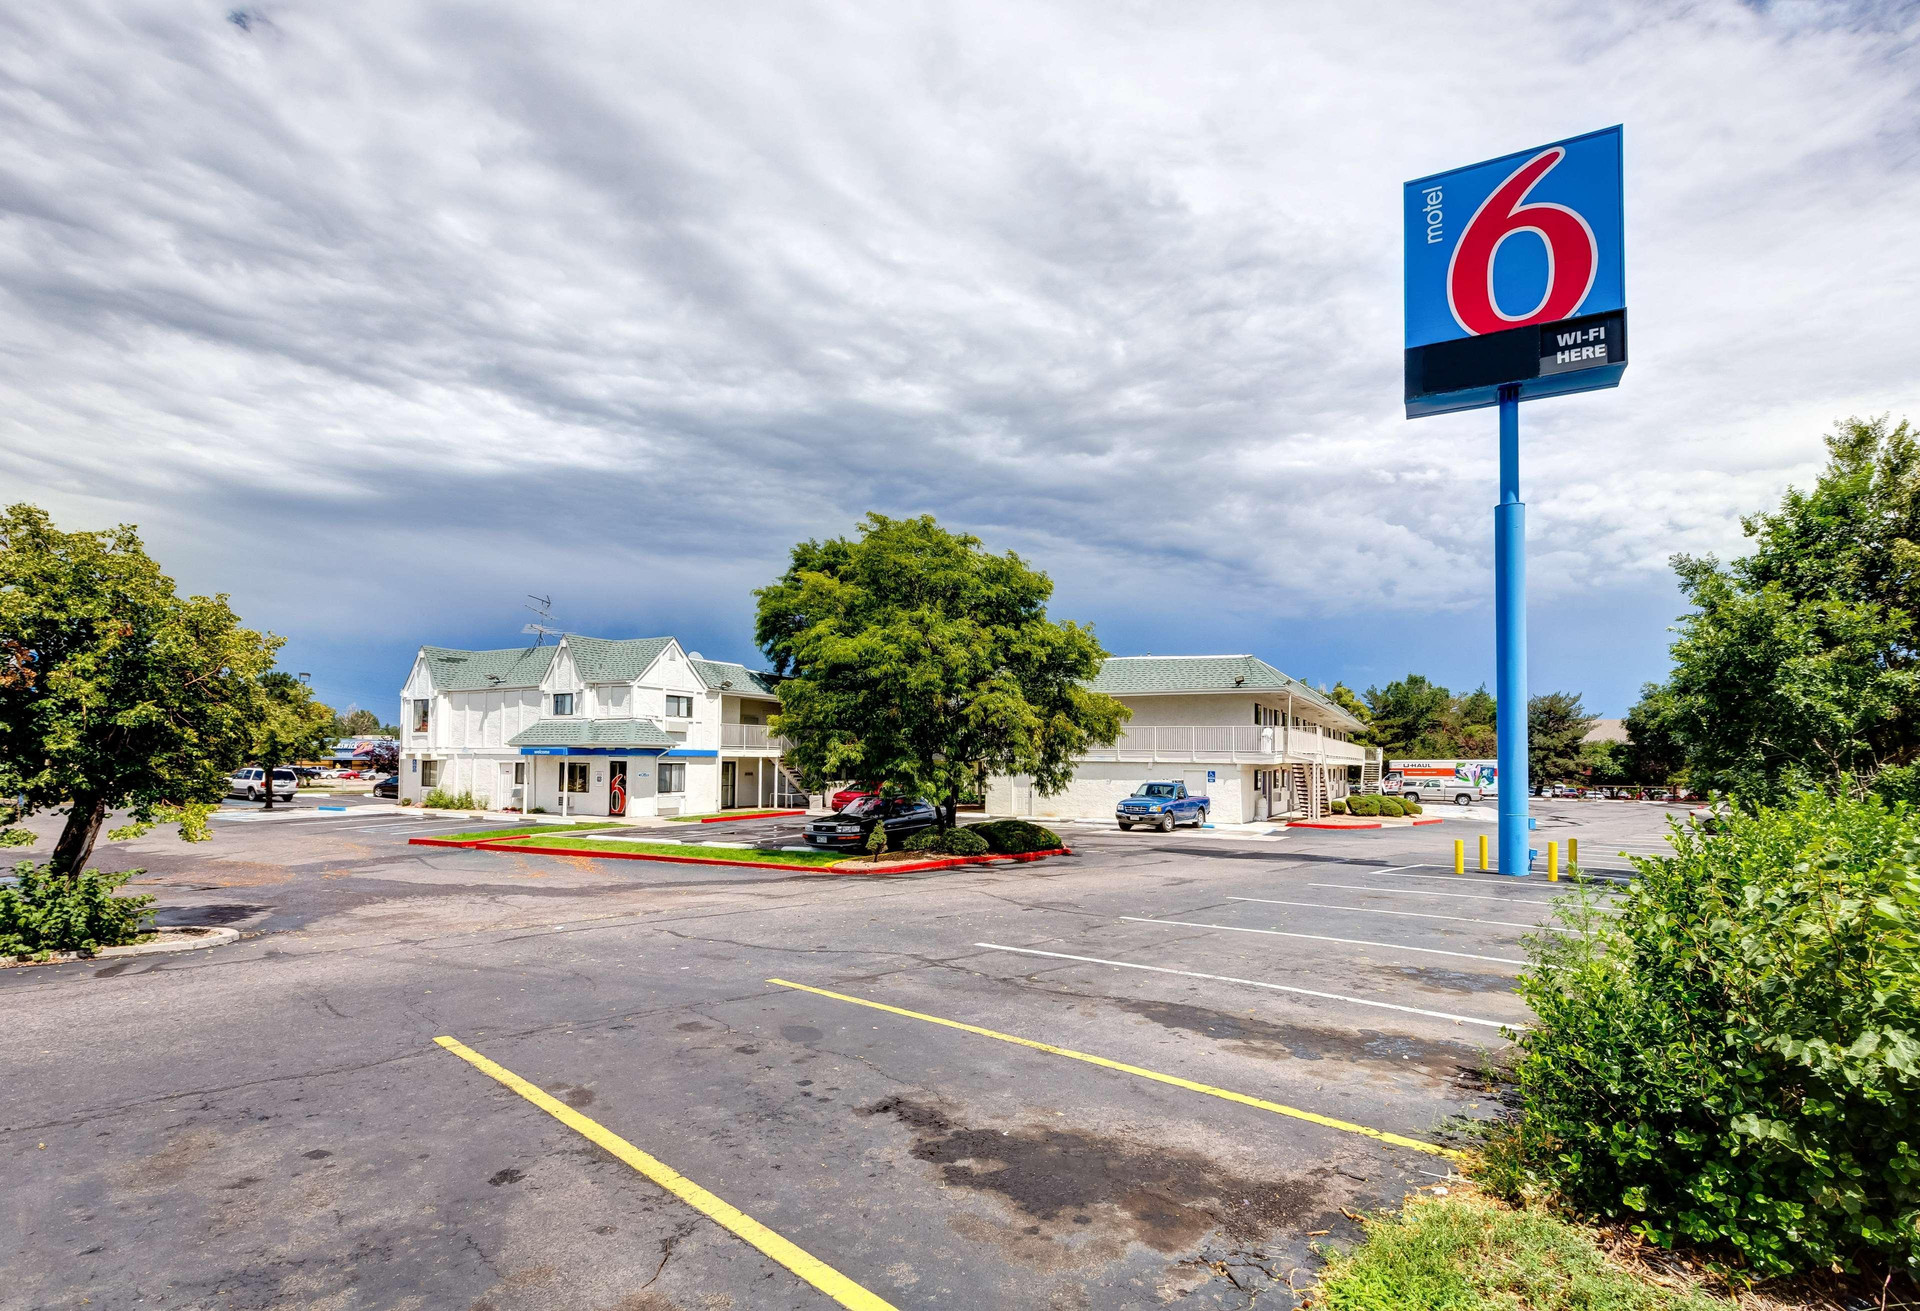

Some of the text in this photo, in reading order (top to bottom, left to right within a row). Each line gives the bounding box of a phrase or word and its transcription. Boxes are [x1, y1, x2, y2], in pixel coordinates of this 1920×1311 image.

[1422, 146, 1599, 336] motel 6
[1556, 326, 1605, 347] WI-FI
[1556, 344, 1606, 364] HERE
